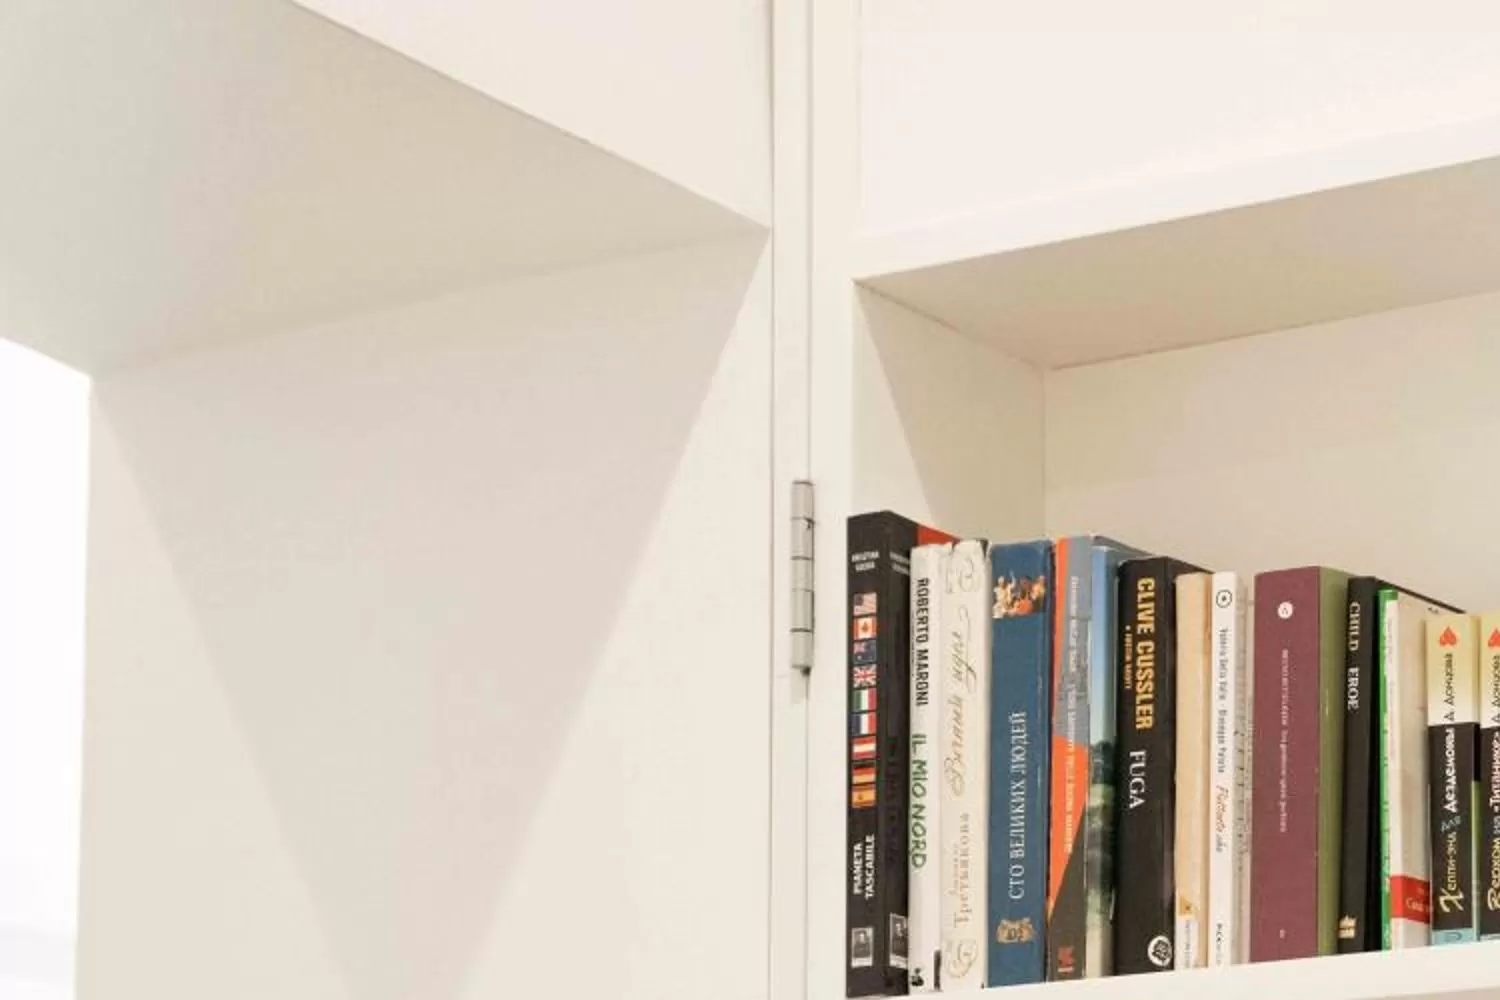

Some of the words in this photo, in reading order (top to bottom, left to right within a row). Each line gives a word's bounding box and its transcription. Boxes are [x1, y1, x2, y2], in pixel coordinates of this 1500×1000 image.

[916, 577, 929, 643] ROBERTO
[1137, 577, 1155, 634] CLIVE
[1349, 602, 1360, 651] CHILD
[916, 649, 929, 707] MARONI
[1136, 640, 1154, 730] CUSSLER
[1348, 667, 1360, 711] EROE
[912, 733, 926, 752] IL
[1009, 711, 1030, 776] ЛЮДЕЙ
[1444, 727, 1457, 813] Дездемоны
[911, 758, 928, 798] MIO
[1130, 750, 1146, 809] FUGA
[910, 804, 927, 869] NORD
[1009, 779, 1025, 859] ВЕЛИКИХ
[853, 842, 863, 895] PIANETA
[865, 834, 875, 900] TASCABILE
[1009, 864, 1024, 900] СТО
